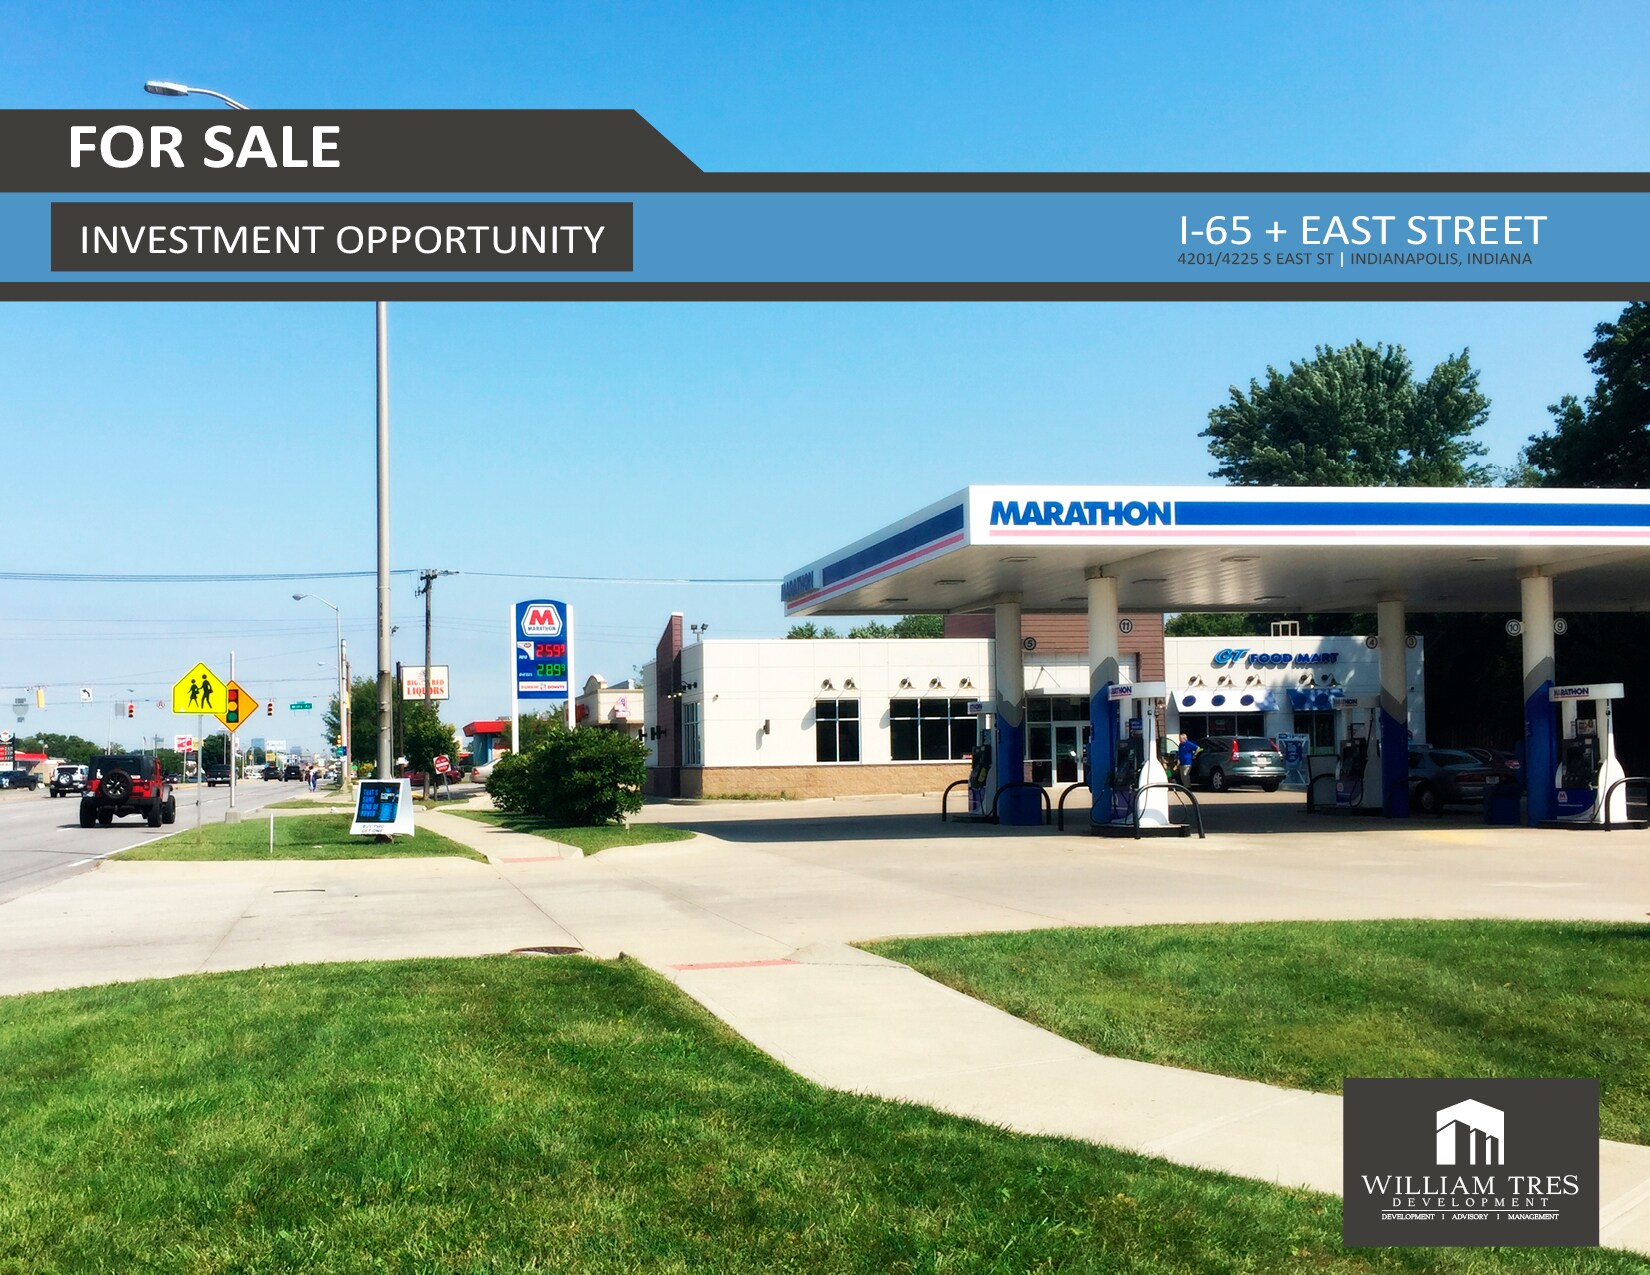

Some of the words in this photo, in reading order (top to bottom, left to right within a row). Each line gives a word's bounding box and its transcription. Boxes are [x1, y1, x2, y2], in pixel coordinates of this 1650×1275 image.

[989, 501, 1171, 526] MARATHON
[529, 609, 555, 626] M
[1122, 622, 1130, 630] 11
[1509, 623, 1519, 631] 10
[1249, 653, 1293, 664] FOOD
[1295, 652, 1340, 664] MART
